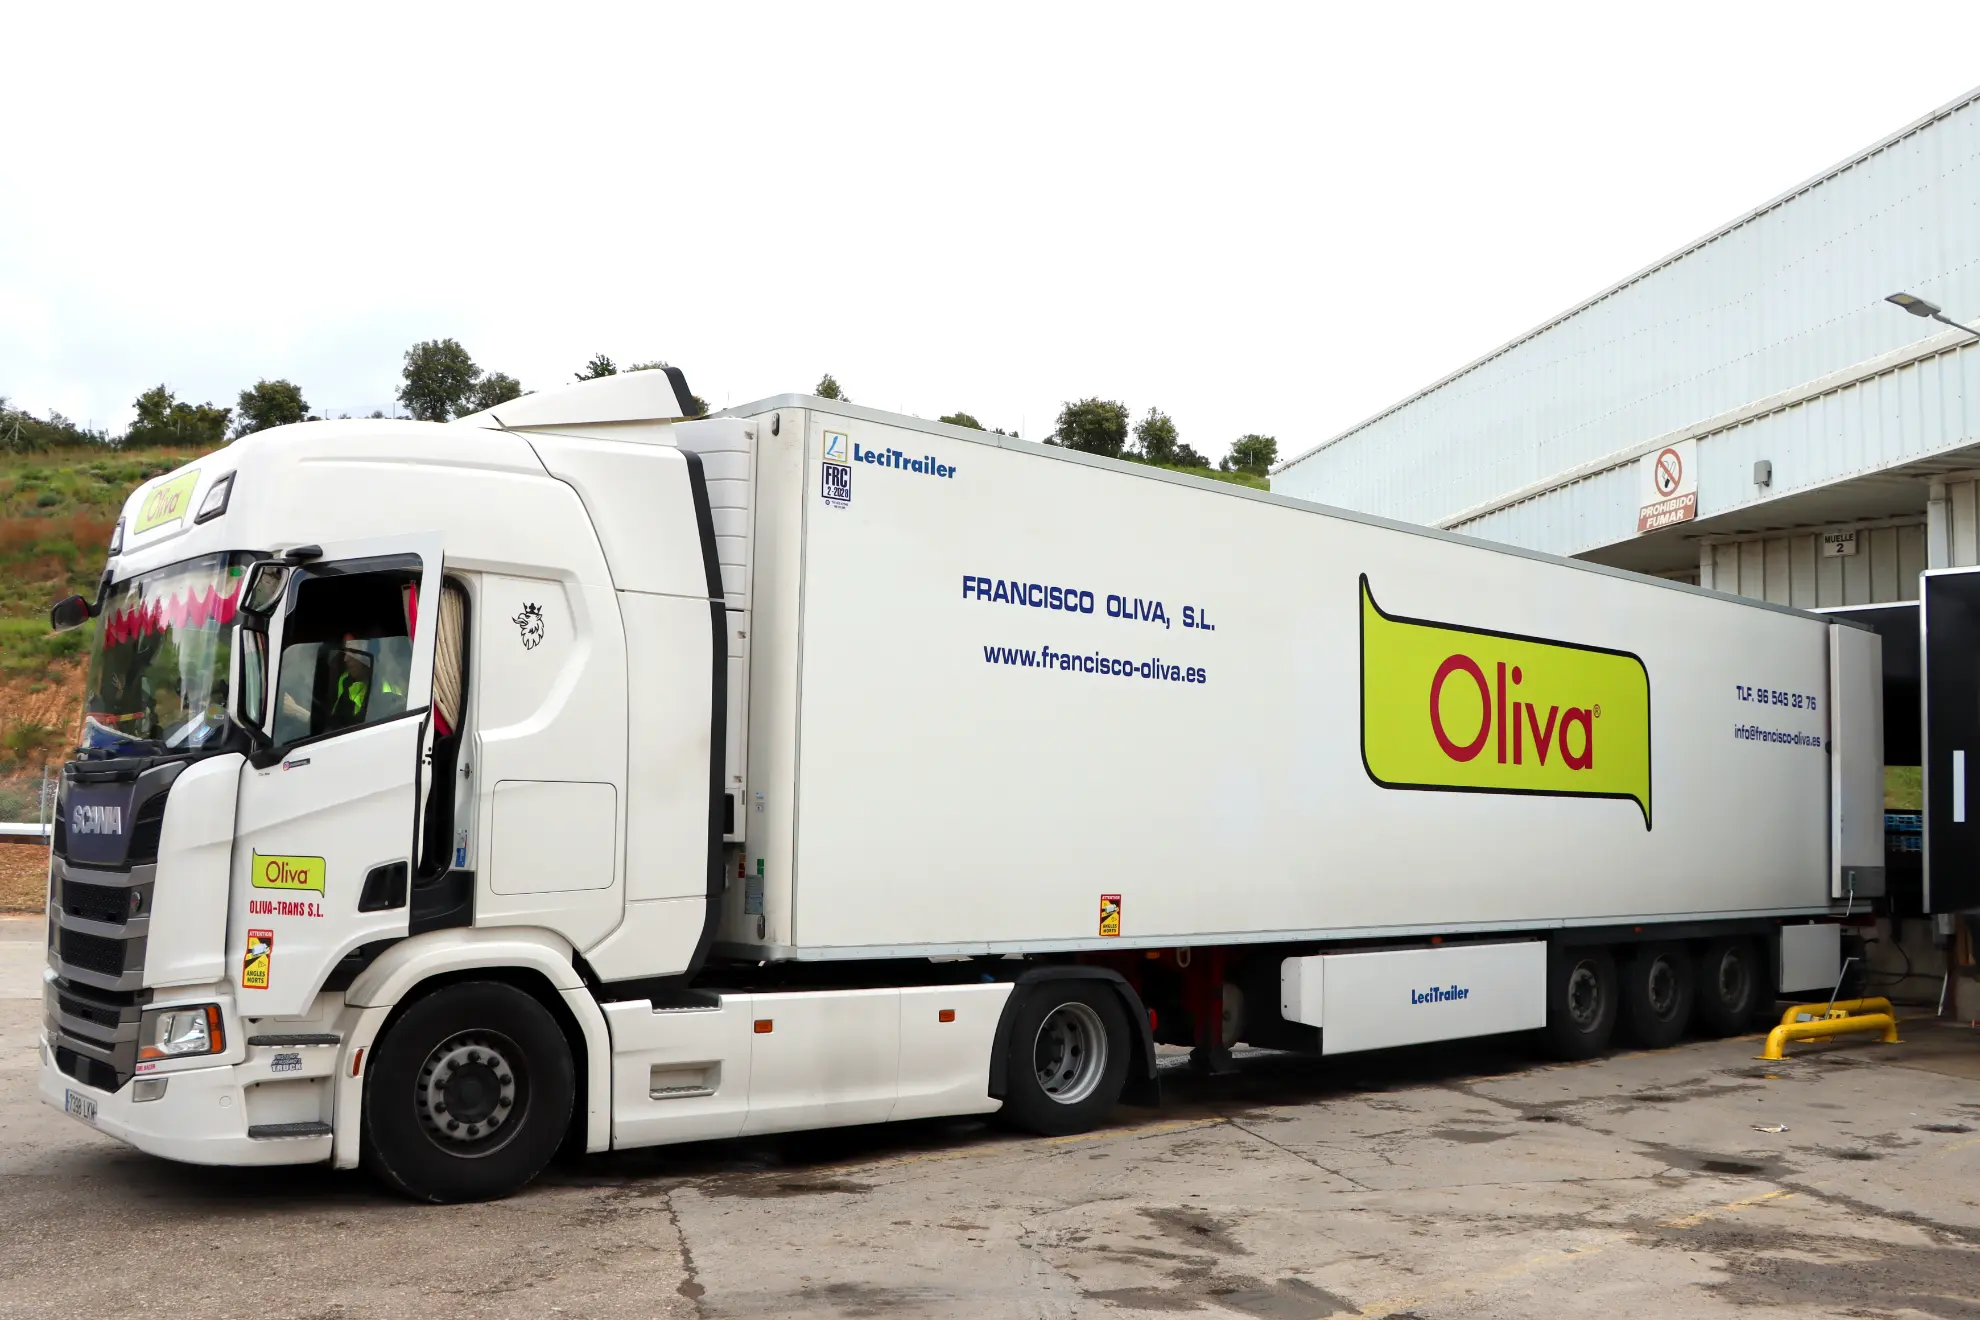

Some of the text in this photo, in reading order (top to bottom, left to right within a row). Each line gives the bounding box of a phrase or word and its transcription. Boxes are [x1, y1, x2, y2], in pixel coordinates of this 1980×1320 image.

[853, 442, 956, 479] LeciTrailer
[825, 465, 848, 488] FRC
[1640, 494, 1694, 519] PROHIBIDO
[1646, 509, 1684, 529] FUMAR
[1824, 534, 1854, 544] MUELLE
[1836, 543, 1845, 553] 2
[962, 575, 1216, 631] FRANCISCO OLIVA, S.L.
[983, 645, 1207, 684] www.francisco-oliva.es
[1736, 685, 1817, 710] TLF. 96 545 32 76
[1734, 724, 1821, 747] info@francisco-oliva.es
[72, 805, 122, 835] SCANIA
[249, 900, 324, 918] OLIVA-TRANS S.L.
[249, 930, 273, 938] ATTENTION
[246, 970, 266, 978] ANGLES
[1411, 984, 1469, 1005] LeciTrailer
[271, 1063, 302, 1072] TRUCK
